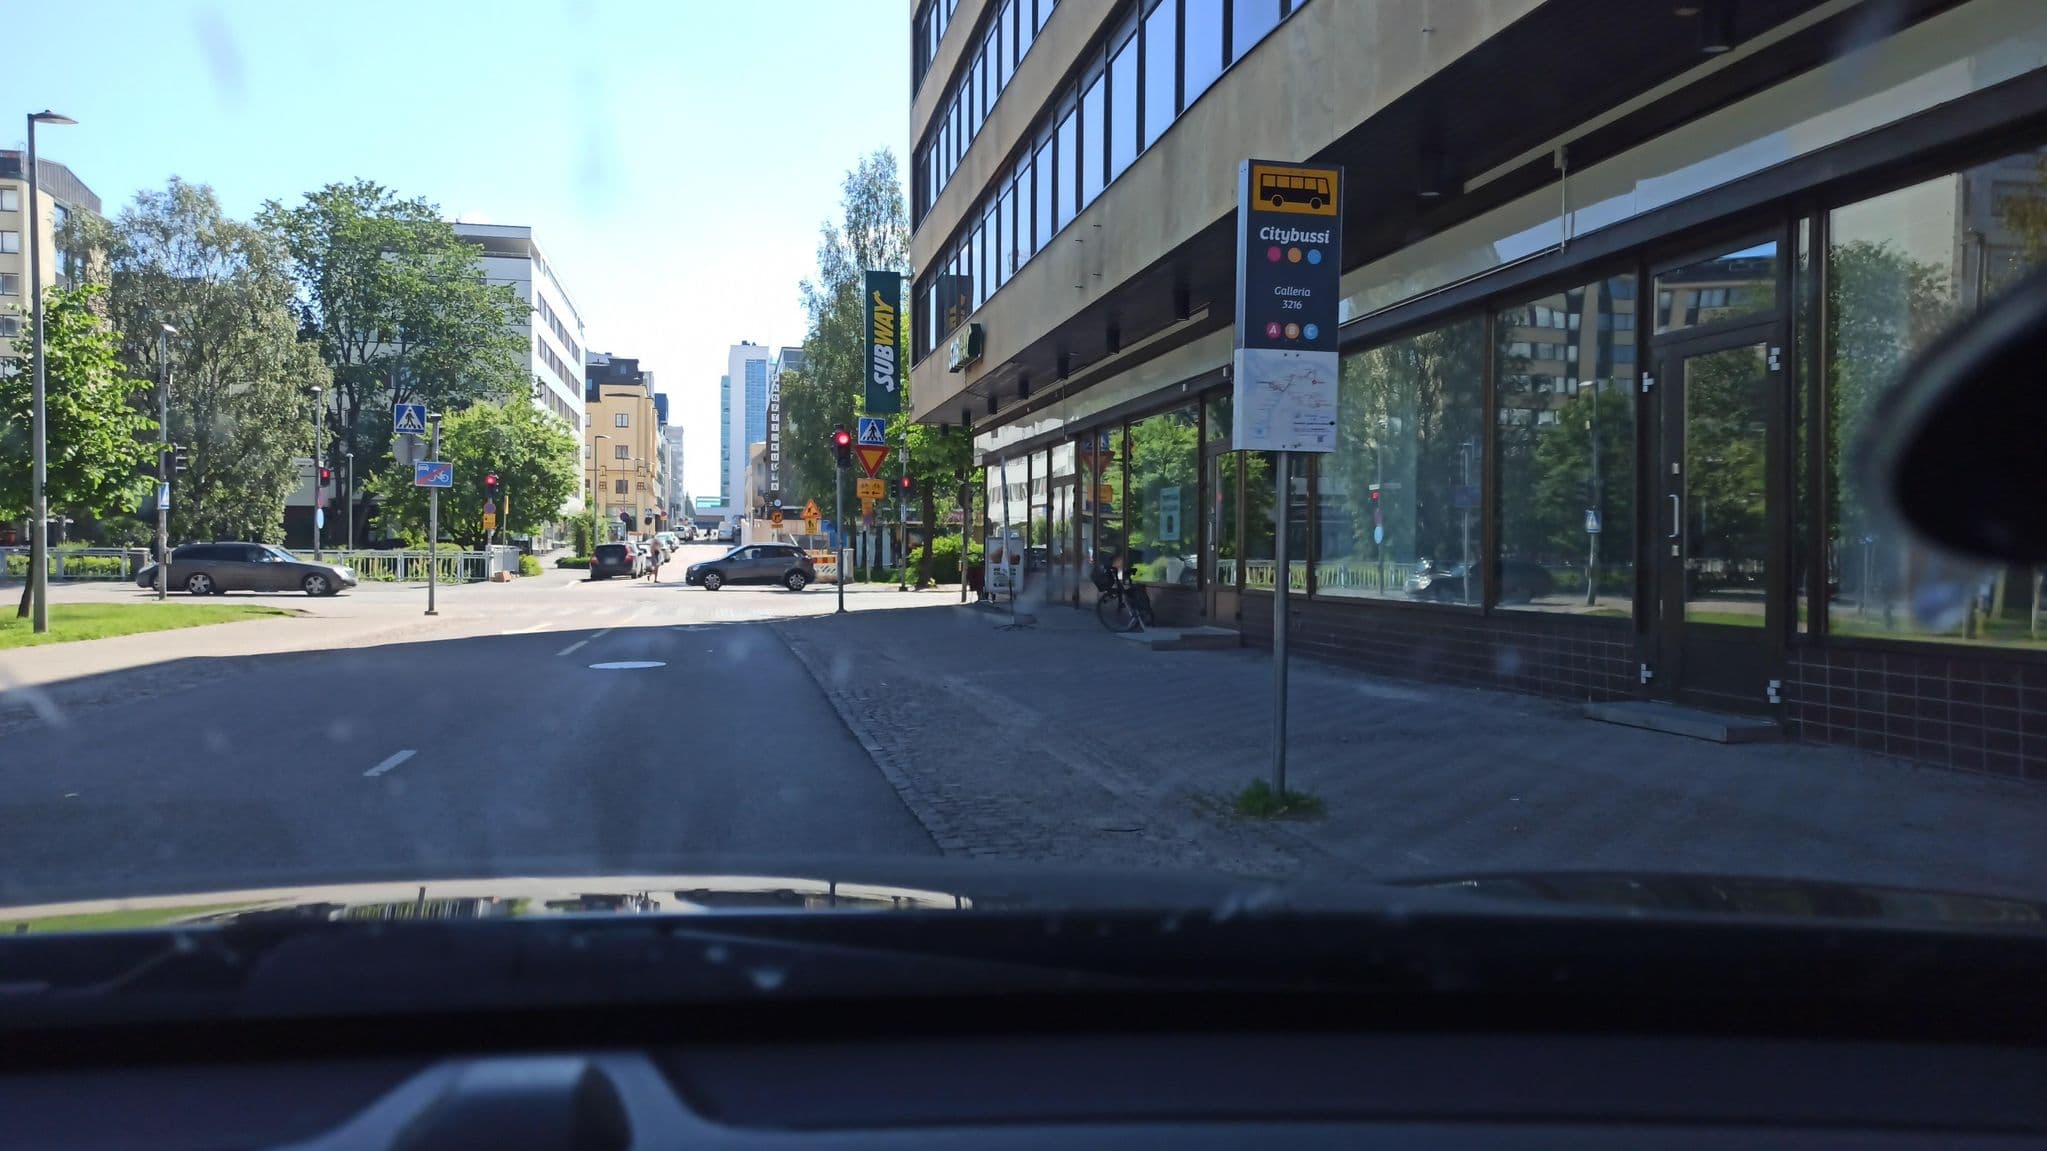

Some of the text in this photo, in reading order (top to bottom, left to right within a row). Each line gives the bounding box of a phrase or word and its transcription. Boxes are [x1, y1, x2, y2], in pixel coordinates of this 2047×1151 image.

[1260, 226, 1330, 244] Citybussi
[1274, 286, 1311, 297] Galleria
[1282, 300, 1303, 310] 3216
[873, 290, 895, 393] SUBWAY
